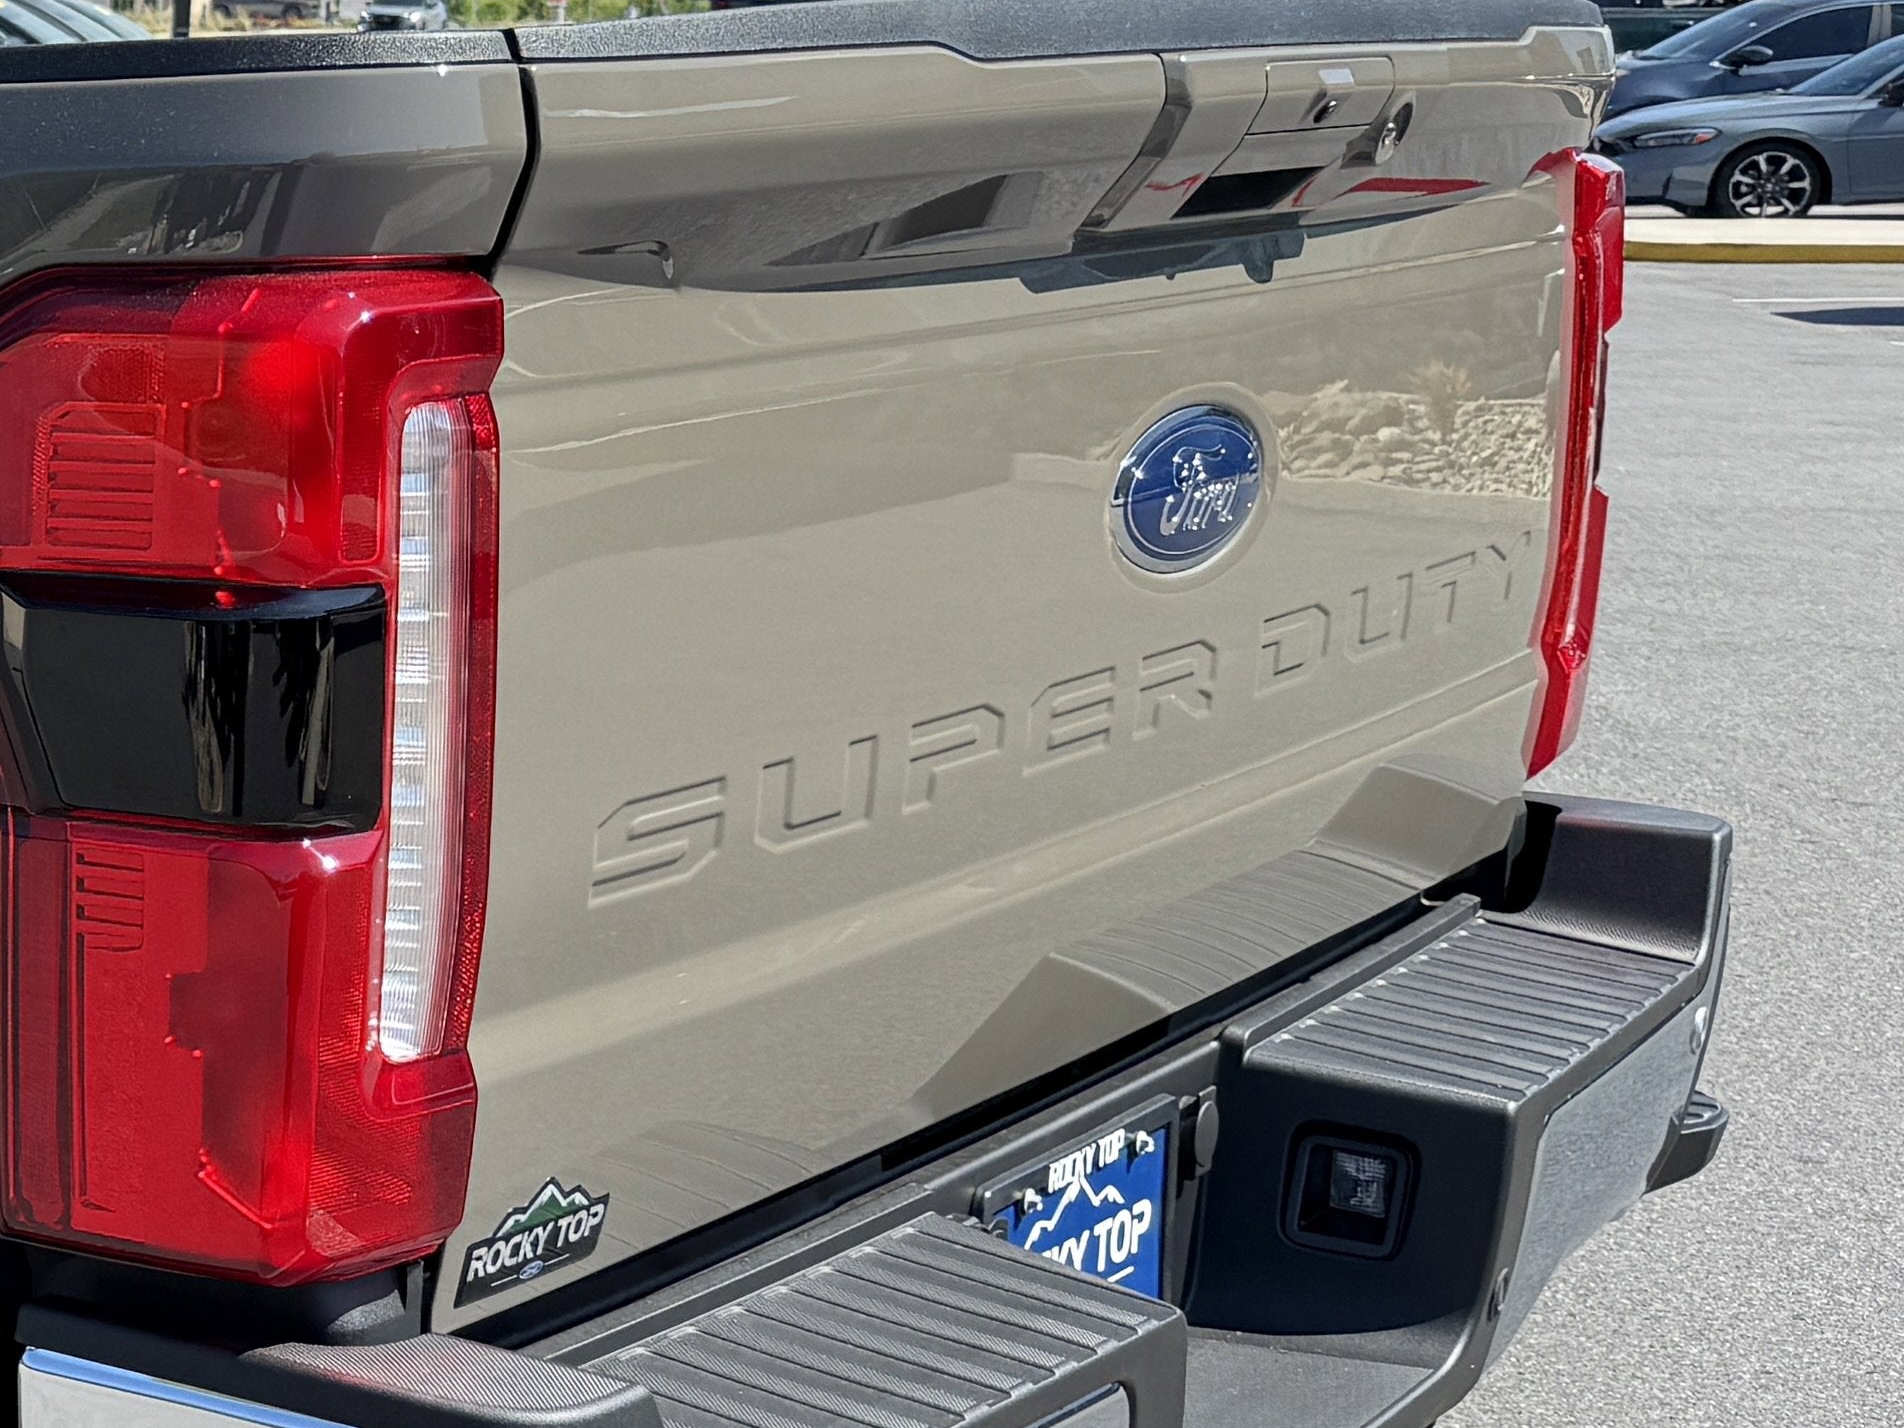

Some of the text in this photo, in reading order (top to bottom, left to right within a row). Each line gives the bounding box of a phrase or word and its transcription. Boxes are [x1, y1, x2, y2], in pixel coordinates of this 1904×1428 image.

[588, 530, 1533, 909] SUPER DUTY
[1098, 1128, 1126, 1168] TOP
[466, 1203, 605, 1283] ROCKY TOP
[1093, 1198, 1153, 1273] TOP
